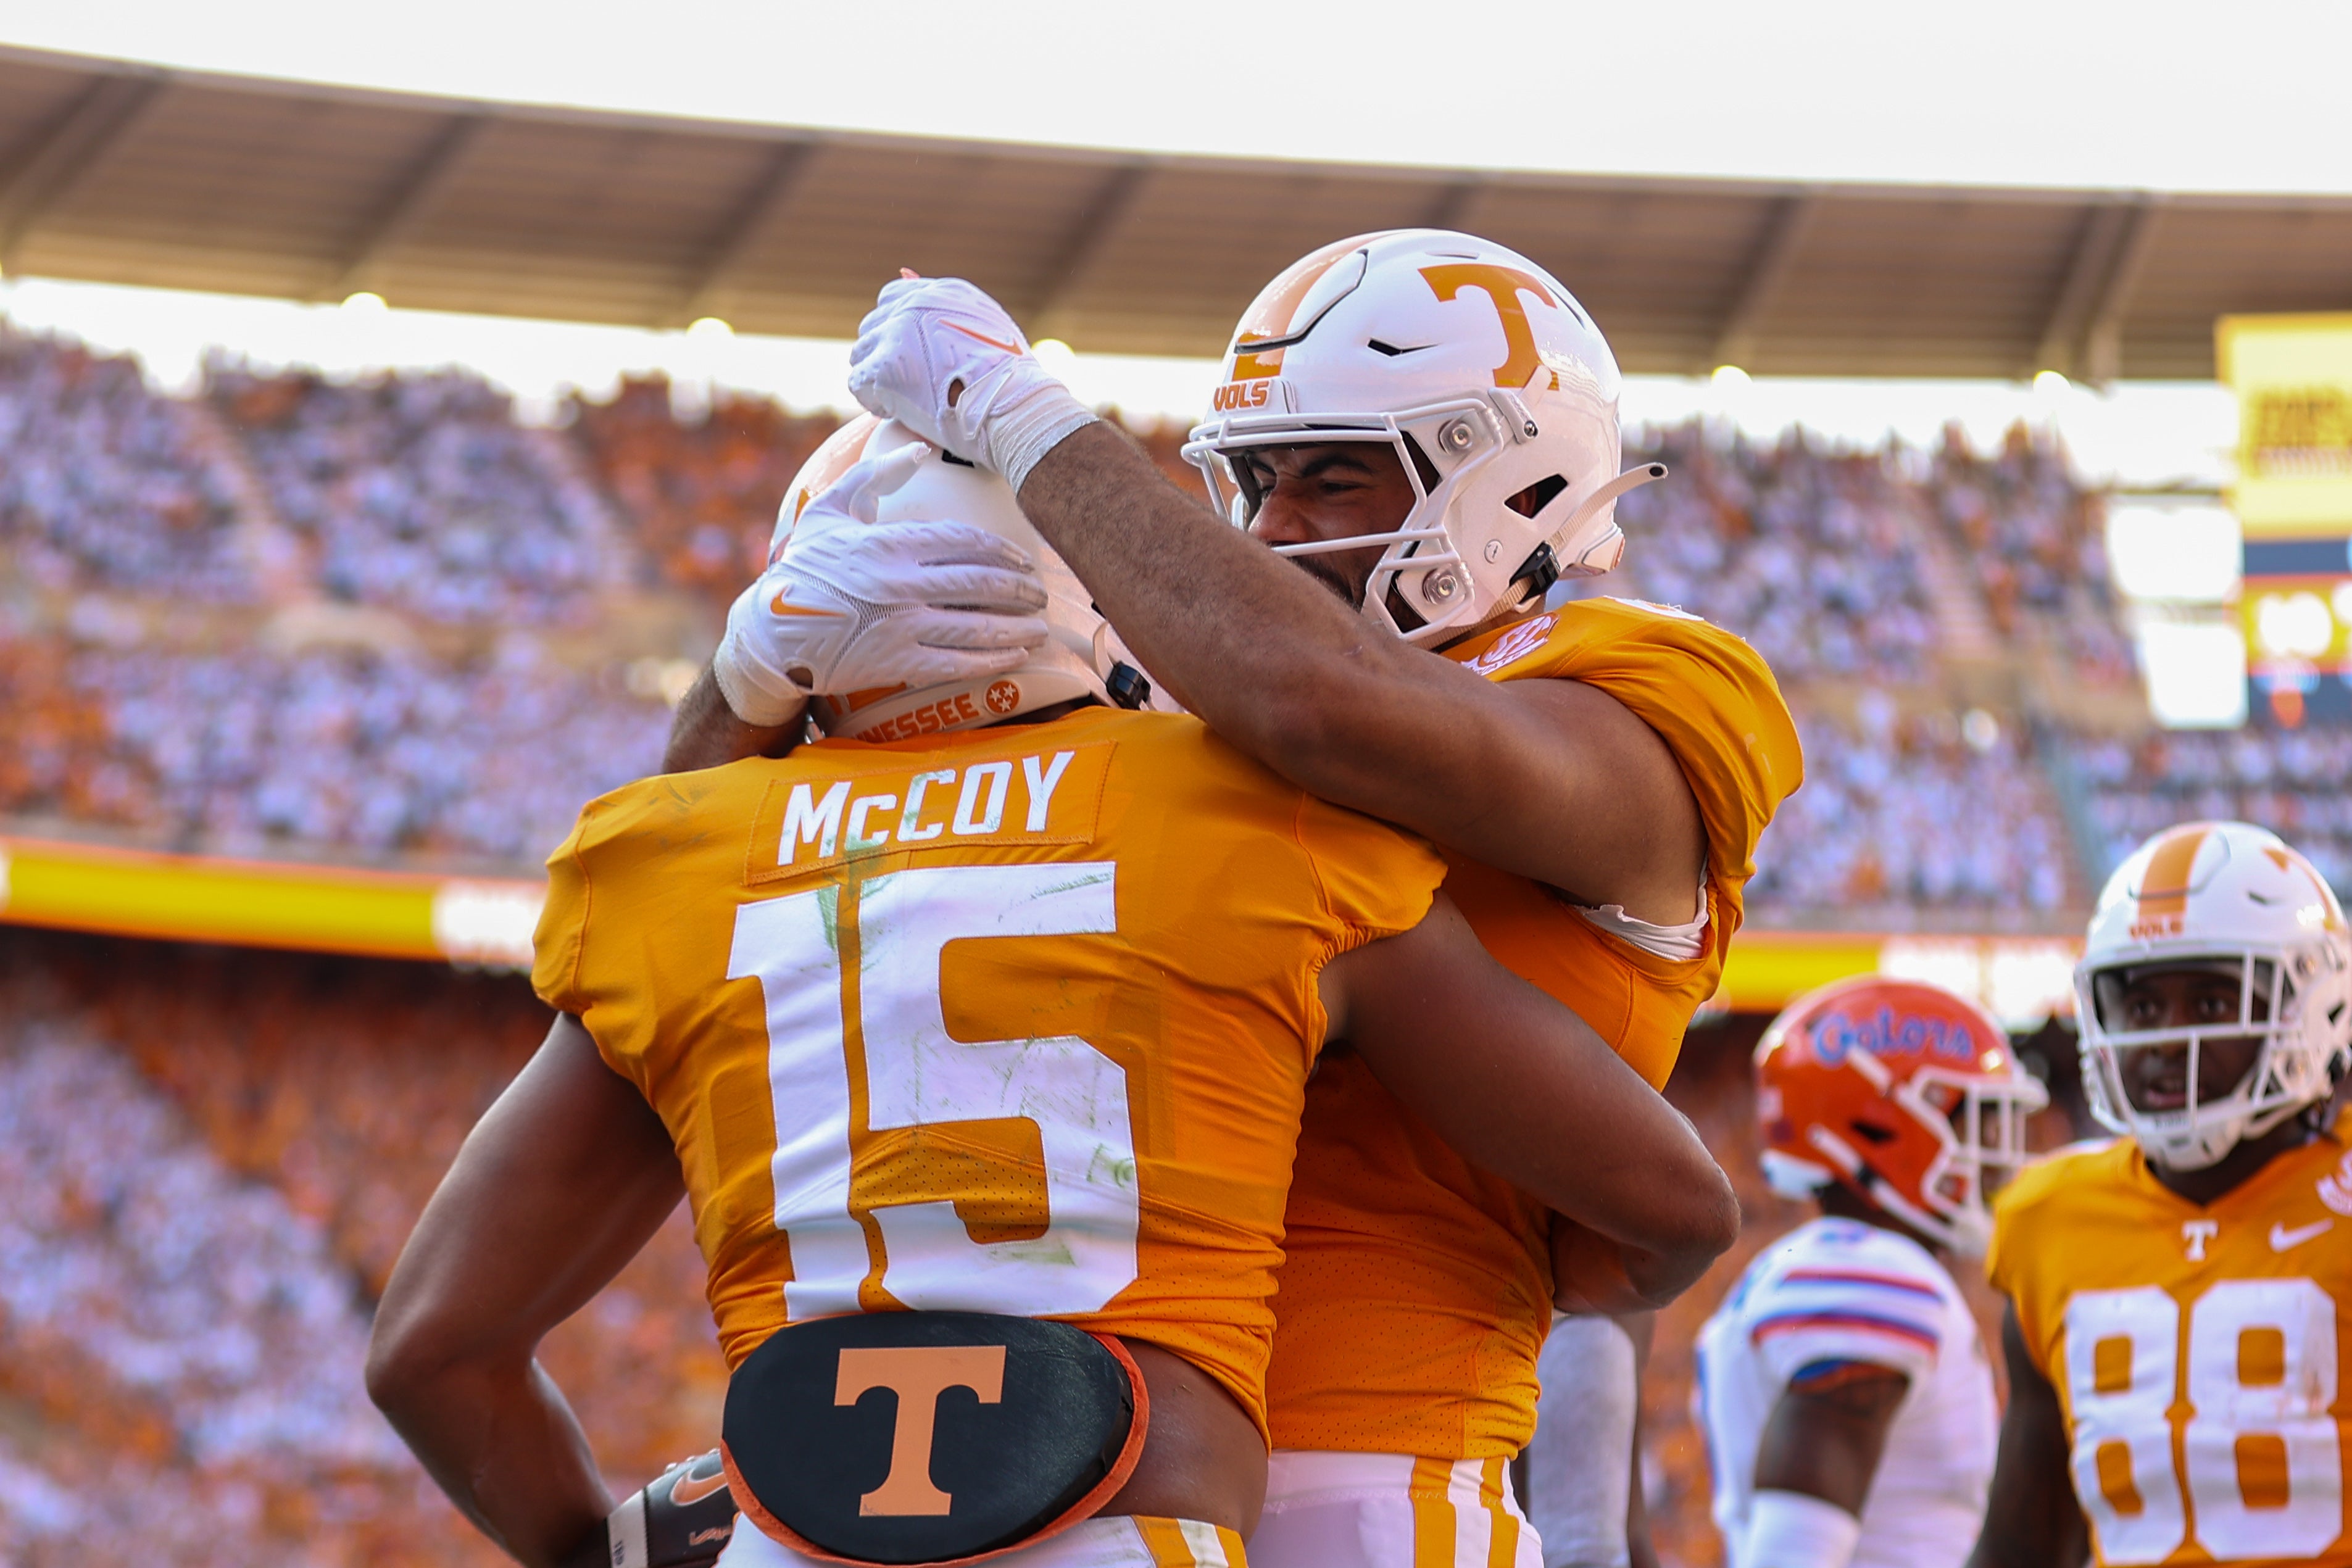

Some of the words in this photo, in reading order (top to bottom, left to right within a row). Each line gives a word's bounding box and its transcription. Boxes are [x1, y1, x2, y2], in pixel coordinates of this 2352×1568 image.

[1417, 263, 1560, 391] T
[1213, 380, 1269, 412] VOLS
[855, 692, 980, 744] NESSEE
[776, 750, 1075, 866] McCOY
[726, 861, 1140, 1322] 15
[1811, 1004, 1973, 1069] Gators
[2180, 1219, 2219, 1262] T
[834, 1345, 1007, 1517] T
[2064, 1276, 2343, 1566] 88
